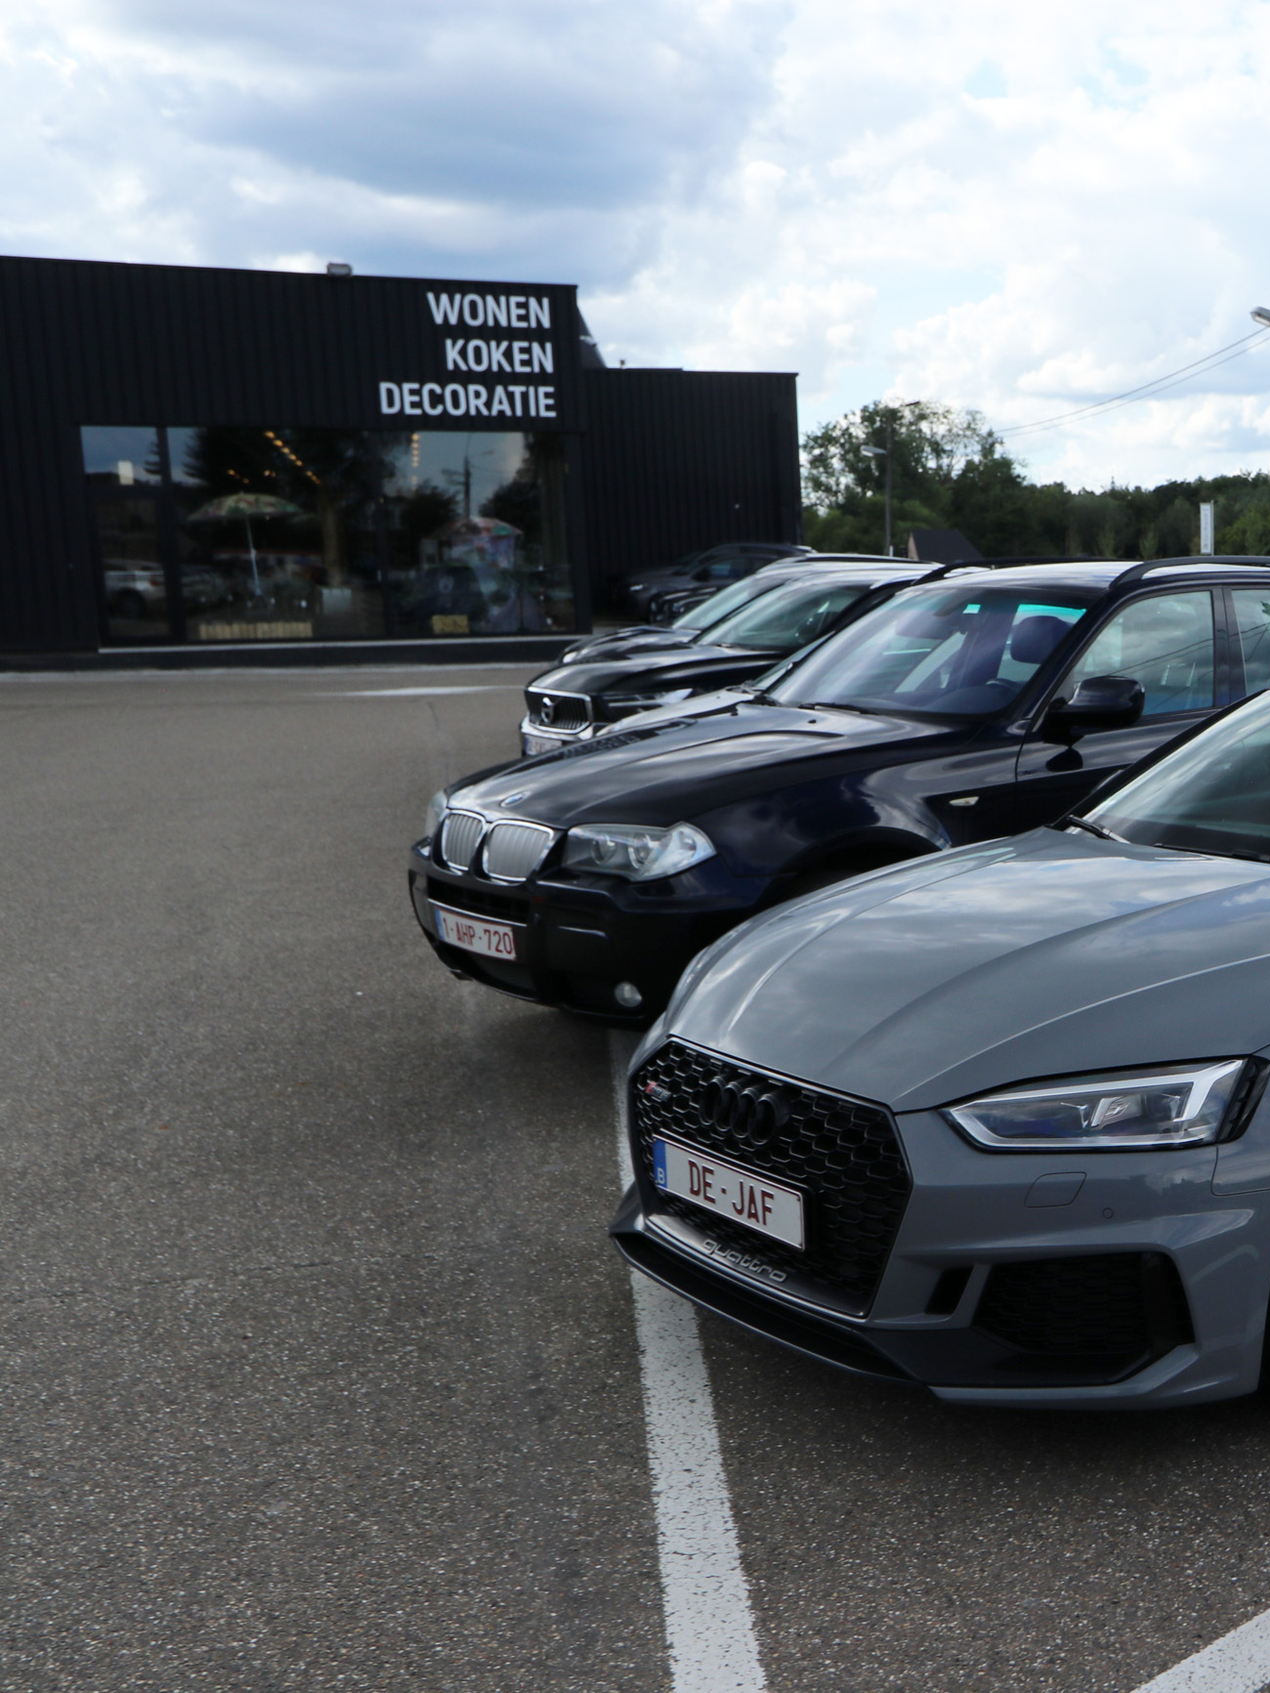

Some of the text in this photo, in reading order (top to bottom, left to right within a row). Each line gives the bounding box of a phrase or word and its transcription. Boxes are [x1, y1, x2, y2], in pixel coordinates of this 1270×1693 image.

[426, 291, 551, 329] WONEN
[445, 338, 554, 374] KOKEN
[379, 381, 557, 418] DECORATIE
[442, 916, 514, 955] 1-AHP-720
[656, 1167, 666, 1184] B
[702, 1239, 787, 1283] quattro
